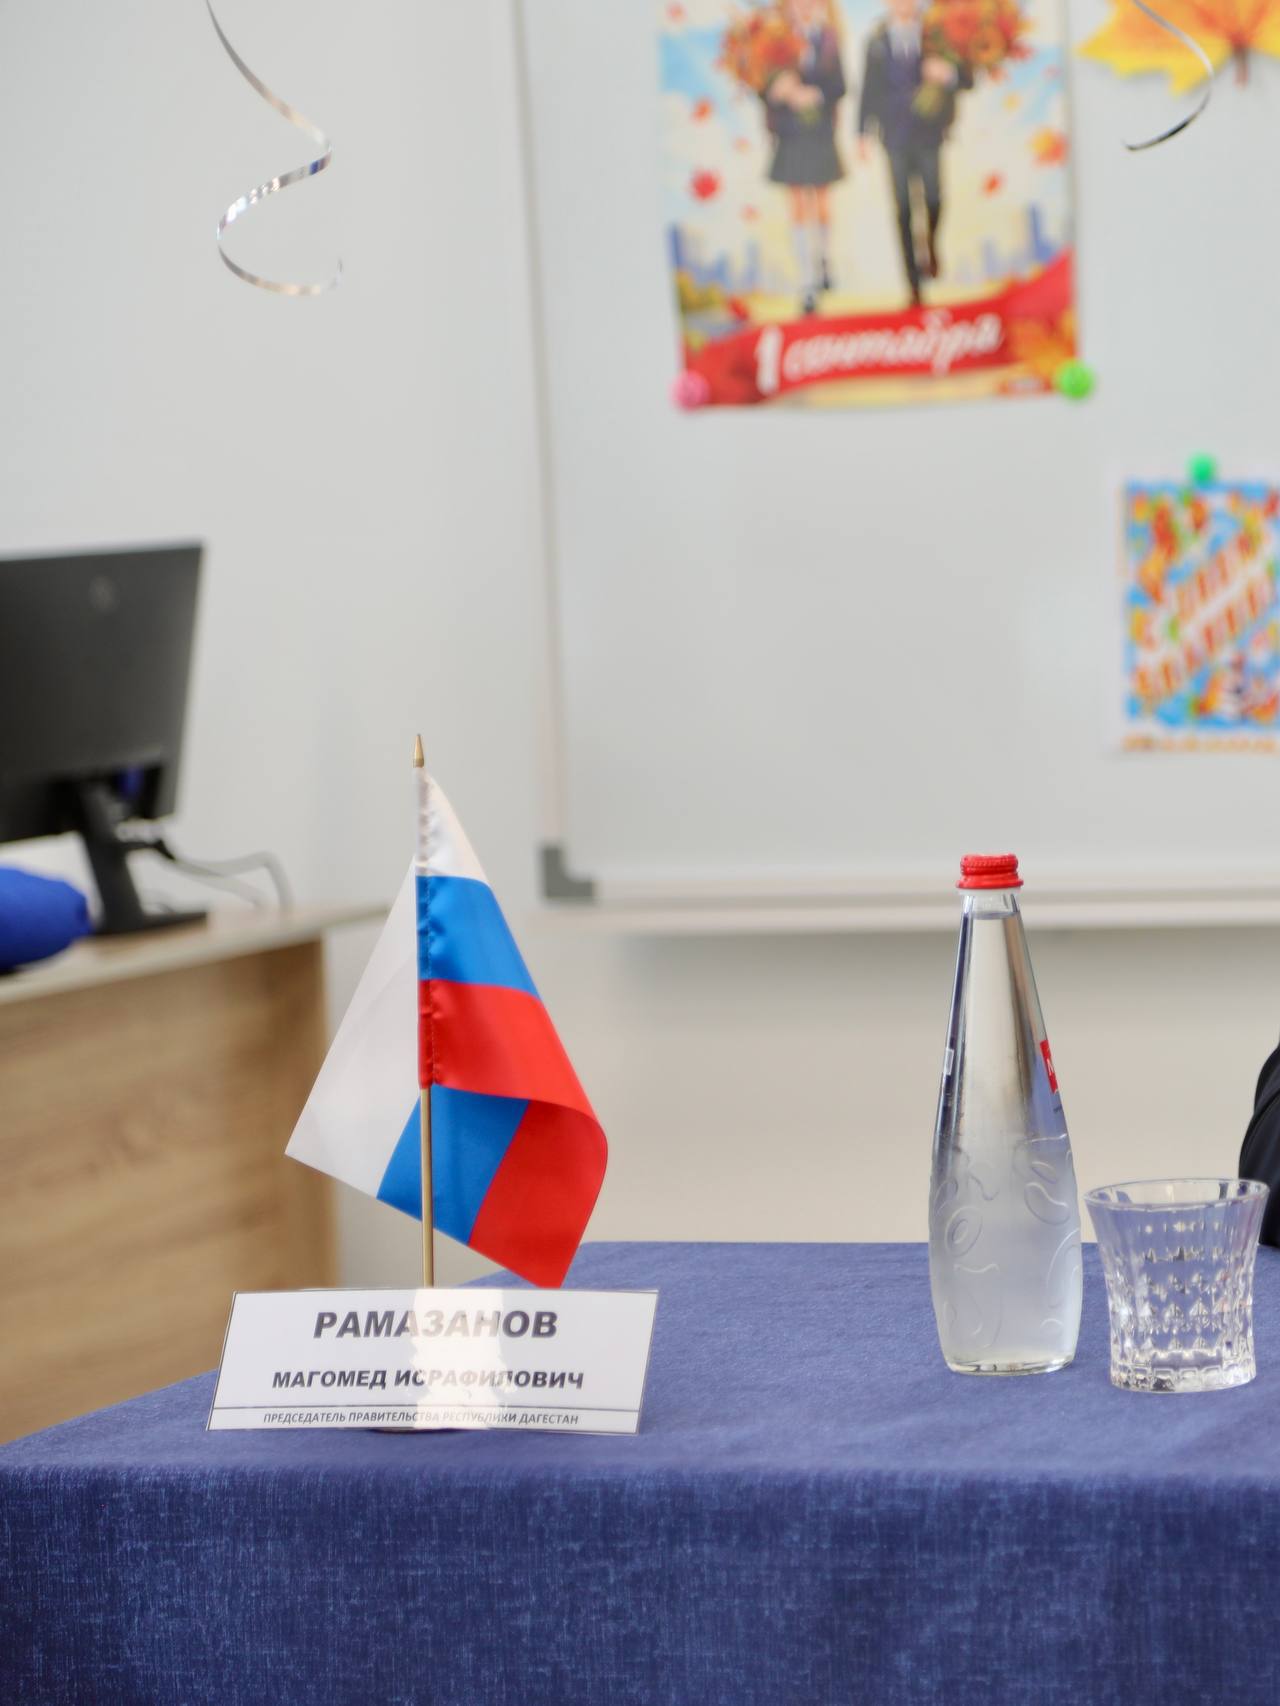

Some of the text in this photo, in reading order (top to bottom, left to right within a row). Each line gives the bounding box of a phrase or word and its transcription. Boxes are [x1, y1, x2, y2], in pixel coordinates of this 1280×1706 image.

[756, 326, 782, 393] 1
[313, 1310, 559, 1339] РАМАЗАНОВ
[272, 1369, 584, 1391] МАГОМЕД ИСРАФИЛОВИЧ
[263, 1411, 579, 1425] ПРЕДСЕДАТЕЛЬ ПРАВИТЕЛЬСТВА РЕСПУБЛИКИ ДАГЕСТАН
